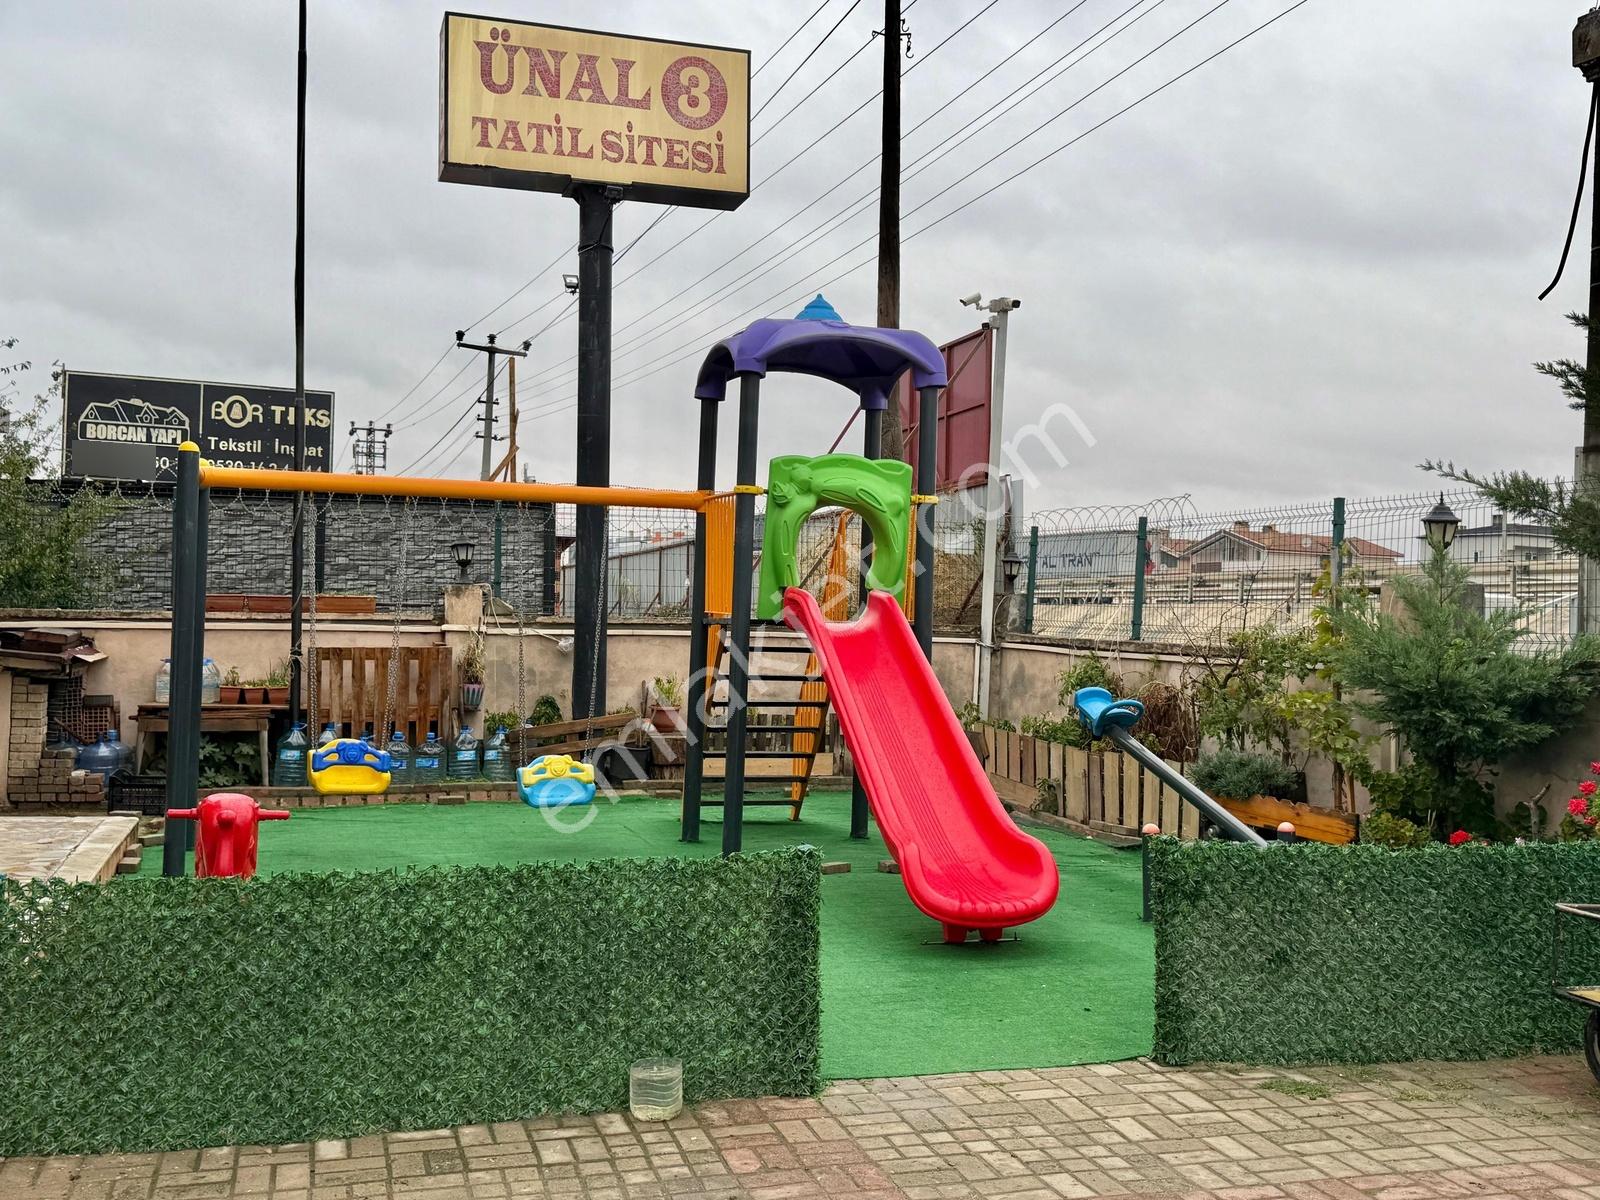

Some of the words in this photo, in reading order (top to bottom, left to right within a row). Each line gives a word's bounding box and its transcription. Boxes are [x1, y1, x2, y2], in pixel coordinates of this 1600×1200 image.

[473, 27, 651, 110] ÜNAL
[472, 113, 594, 159] TATİL
[601, 121, 726, 175] SİTESİ
[86, 423, 147, 442] BORCAN
[150, 428, 182, 444] YAPI
[208, 436, 261, 453] Tekstil
